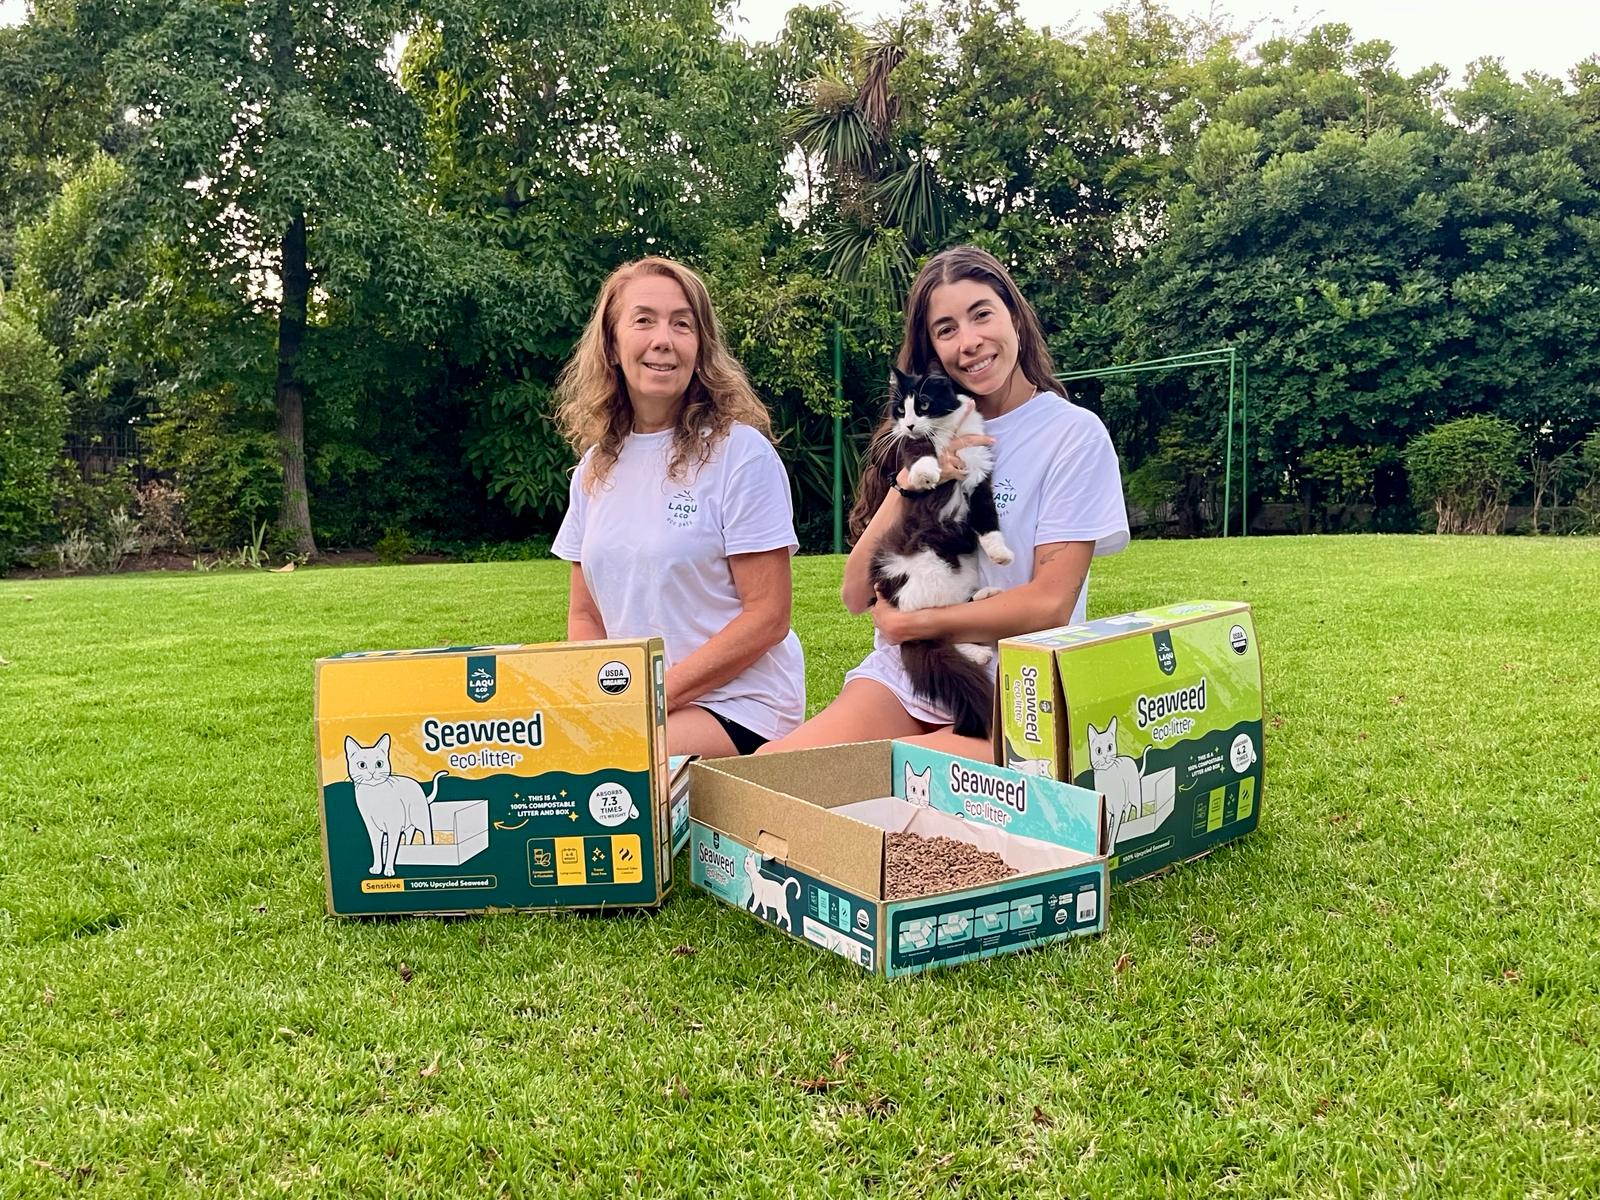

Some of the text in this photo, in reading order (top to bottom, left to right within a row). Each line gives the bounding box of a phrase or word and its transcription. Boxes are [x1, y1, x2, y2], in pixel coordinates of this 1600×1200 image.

[993, 493, 1017, 503] AQU
[668, 502, 698, 513] LAQU
[605, 669, 624, 677] USDA
[469, 679, 494, 688] LAQU
[1021, 666, 1042, 743] Seaweed
[1138, 679, 1206, 728] Seaweed
[424, 713, 543, 752] Seaweed
[1153, 719, 1192, 741] eco-litter
[450, 749, 516, 769] eco-litter
[596, 789, 623, 797] ABSORBS
[951, 763, 1025, 812] Seaweed
[528, 800, 576, 809] COMPOSTABLE
[602, 796, 618, 807] 7.3
[600, 805, 623, 814] TIMES
[965, 800, 1007, 825] eco-litter
[699, 841, 735, 878] Seaweed
[366, 882, 401, 890] Sensitive
[410, 879, 490, 889] 100% Upcycled Seaweed
